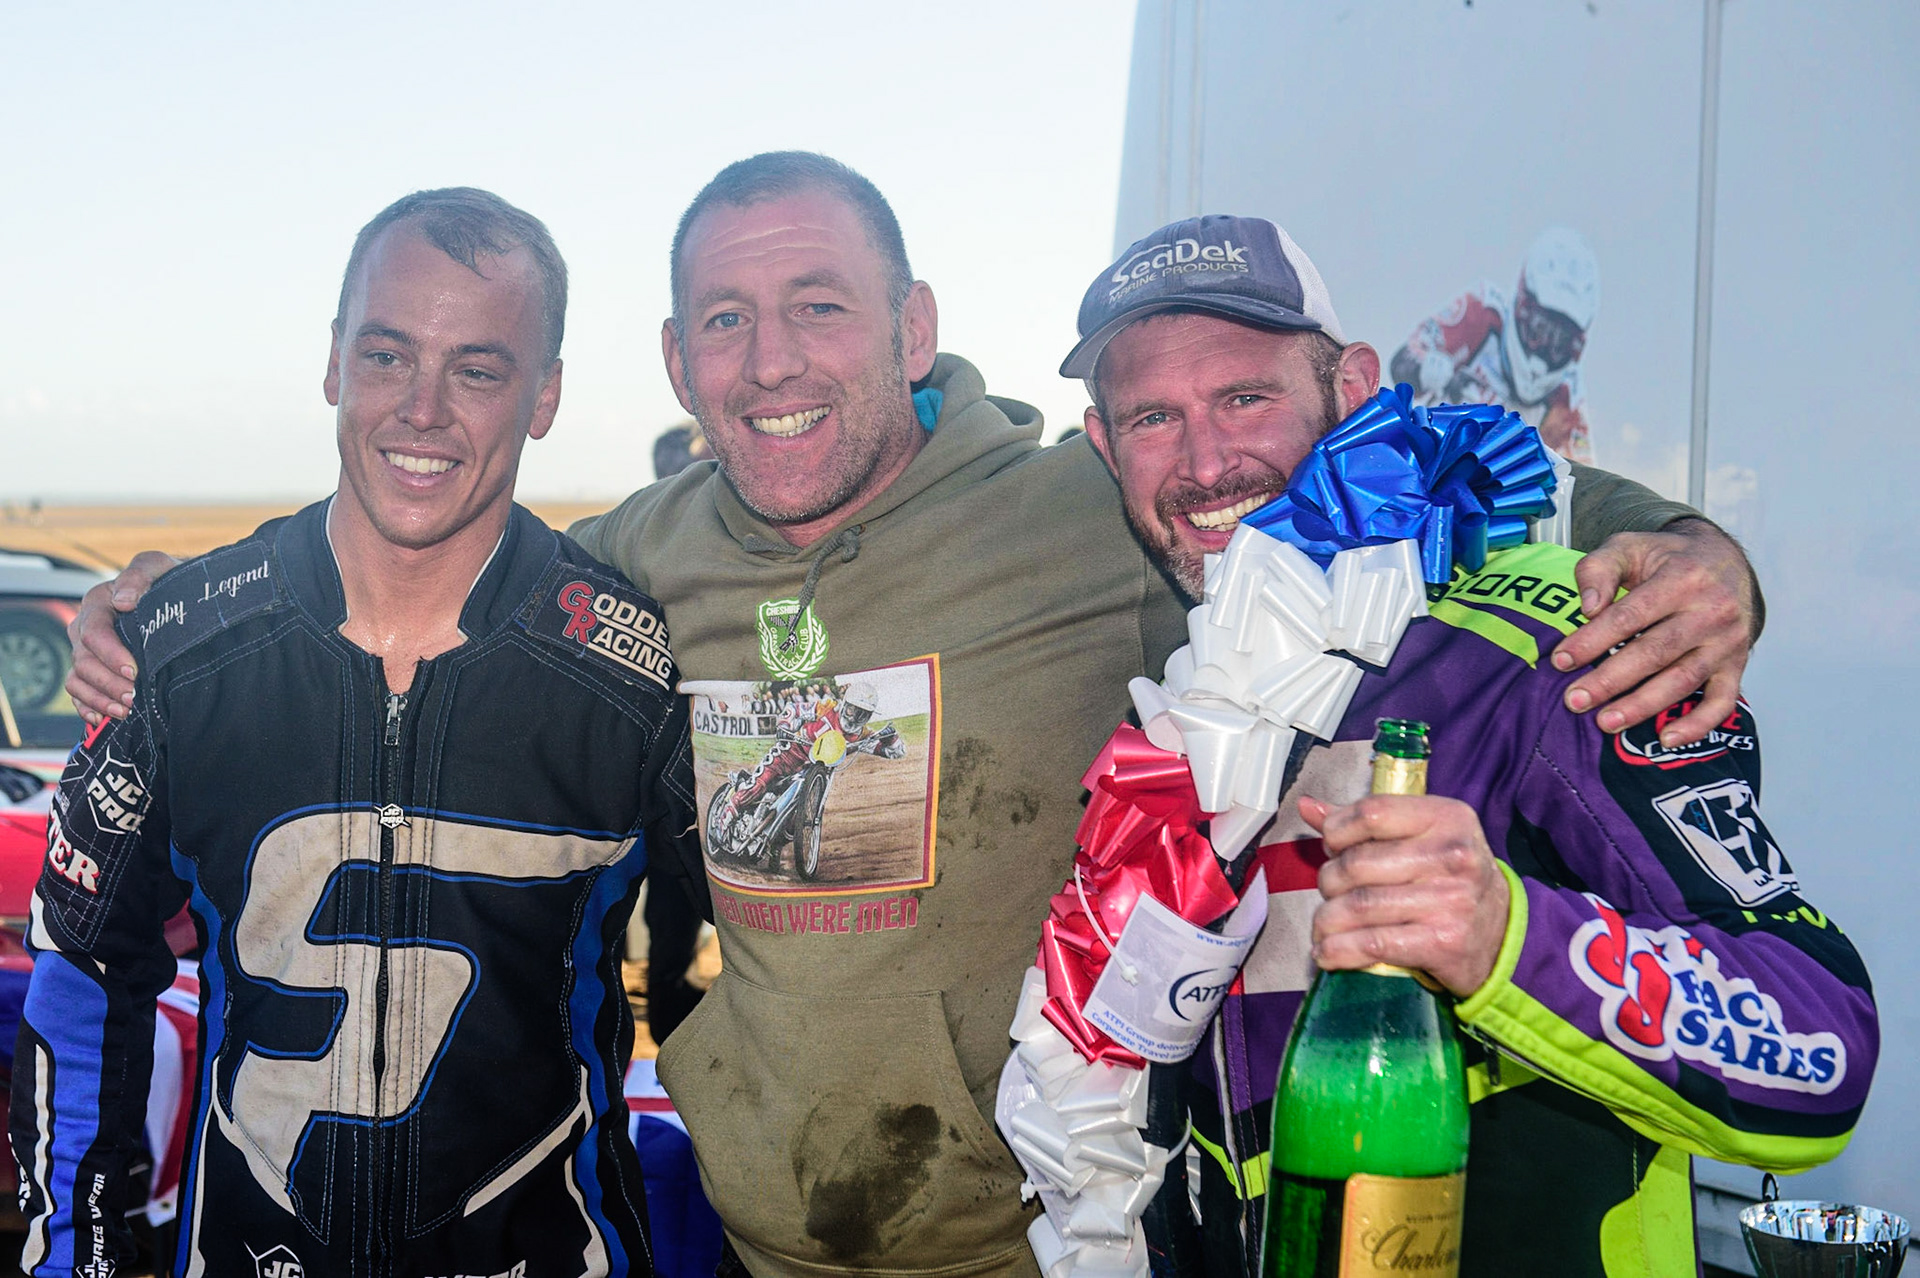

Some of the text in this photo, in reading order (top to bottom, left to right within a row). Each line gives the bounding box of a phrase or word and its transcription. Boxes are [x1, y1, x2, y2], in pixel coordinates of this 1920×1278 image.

[1109, 238, 1247, 296] SeaDek
[1109, 262, 1249, 304] MARINE PRODUCTS
[197, 560, 270, 604] Legend
[558, 581, 671, 650] GODDE
[770, 627, 809, 668] GRASS TRACK CLUB
[694, 712, 753, 736] CASTROL
[87, 777, 146, 832] PRO
[105, 772, 144, 806] JC
[742, 902, 785, 934] MEN
[786, 901, 850, 936] WERE
[856, 896, 920, 935] MEN
[1091, 1012, 1136, 1046] Corporate
[1137, 1043, 1170, 1059] Travel
[1103, 1009, 1126, 1030] ATPI
[1125, 1026, 1155, 1047] Group
